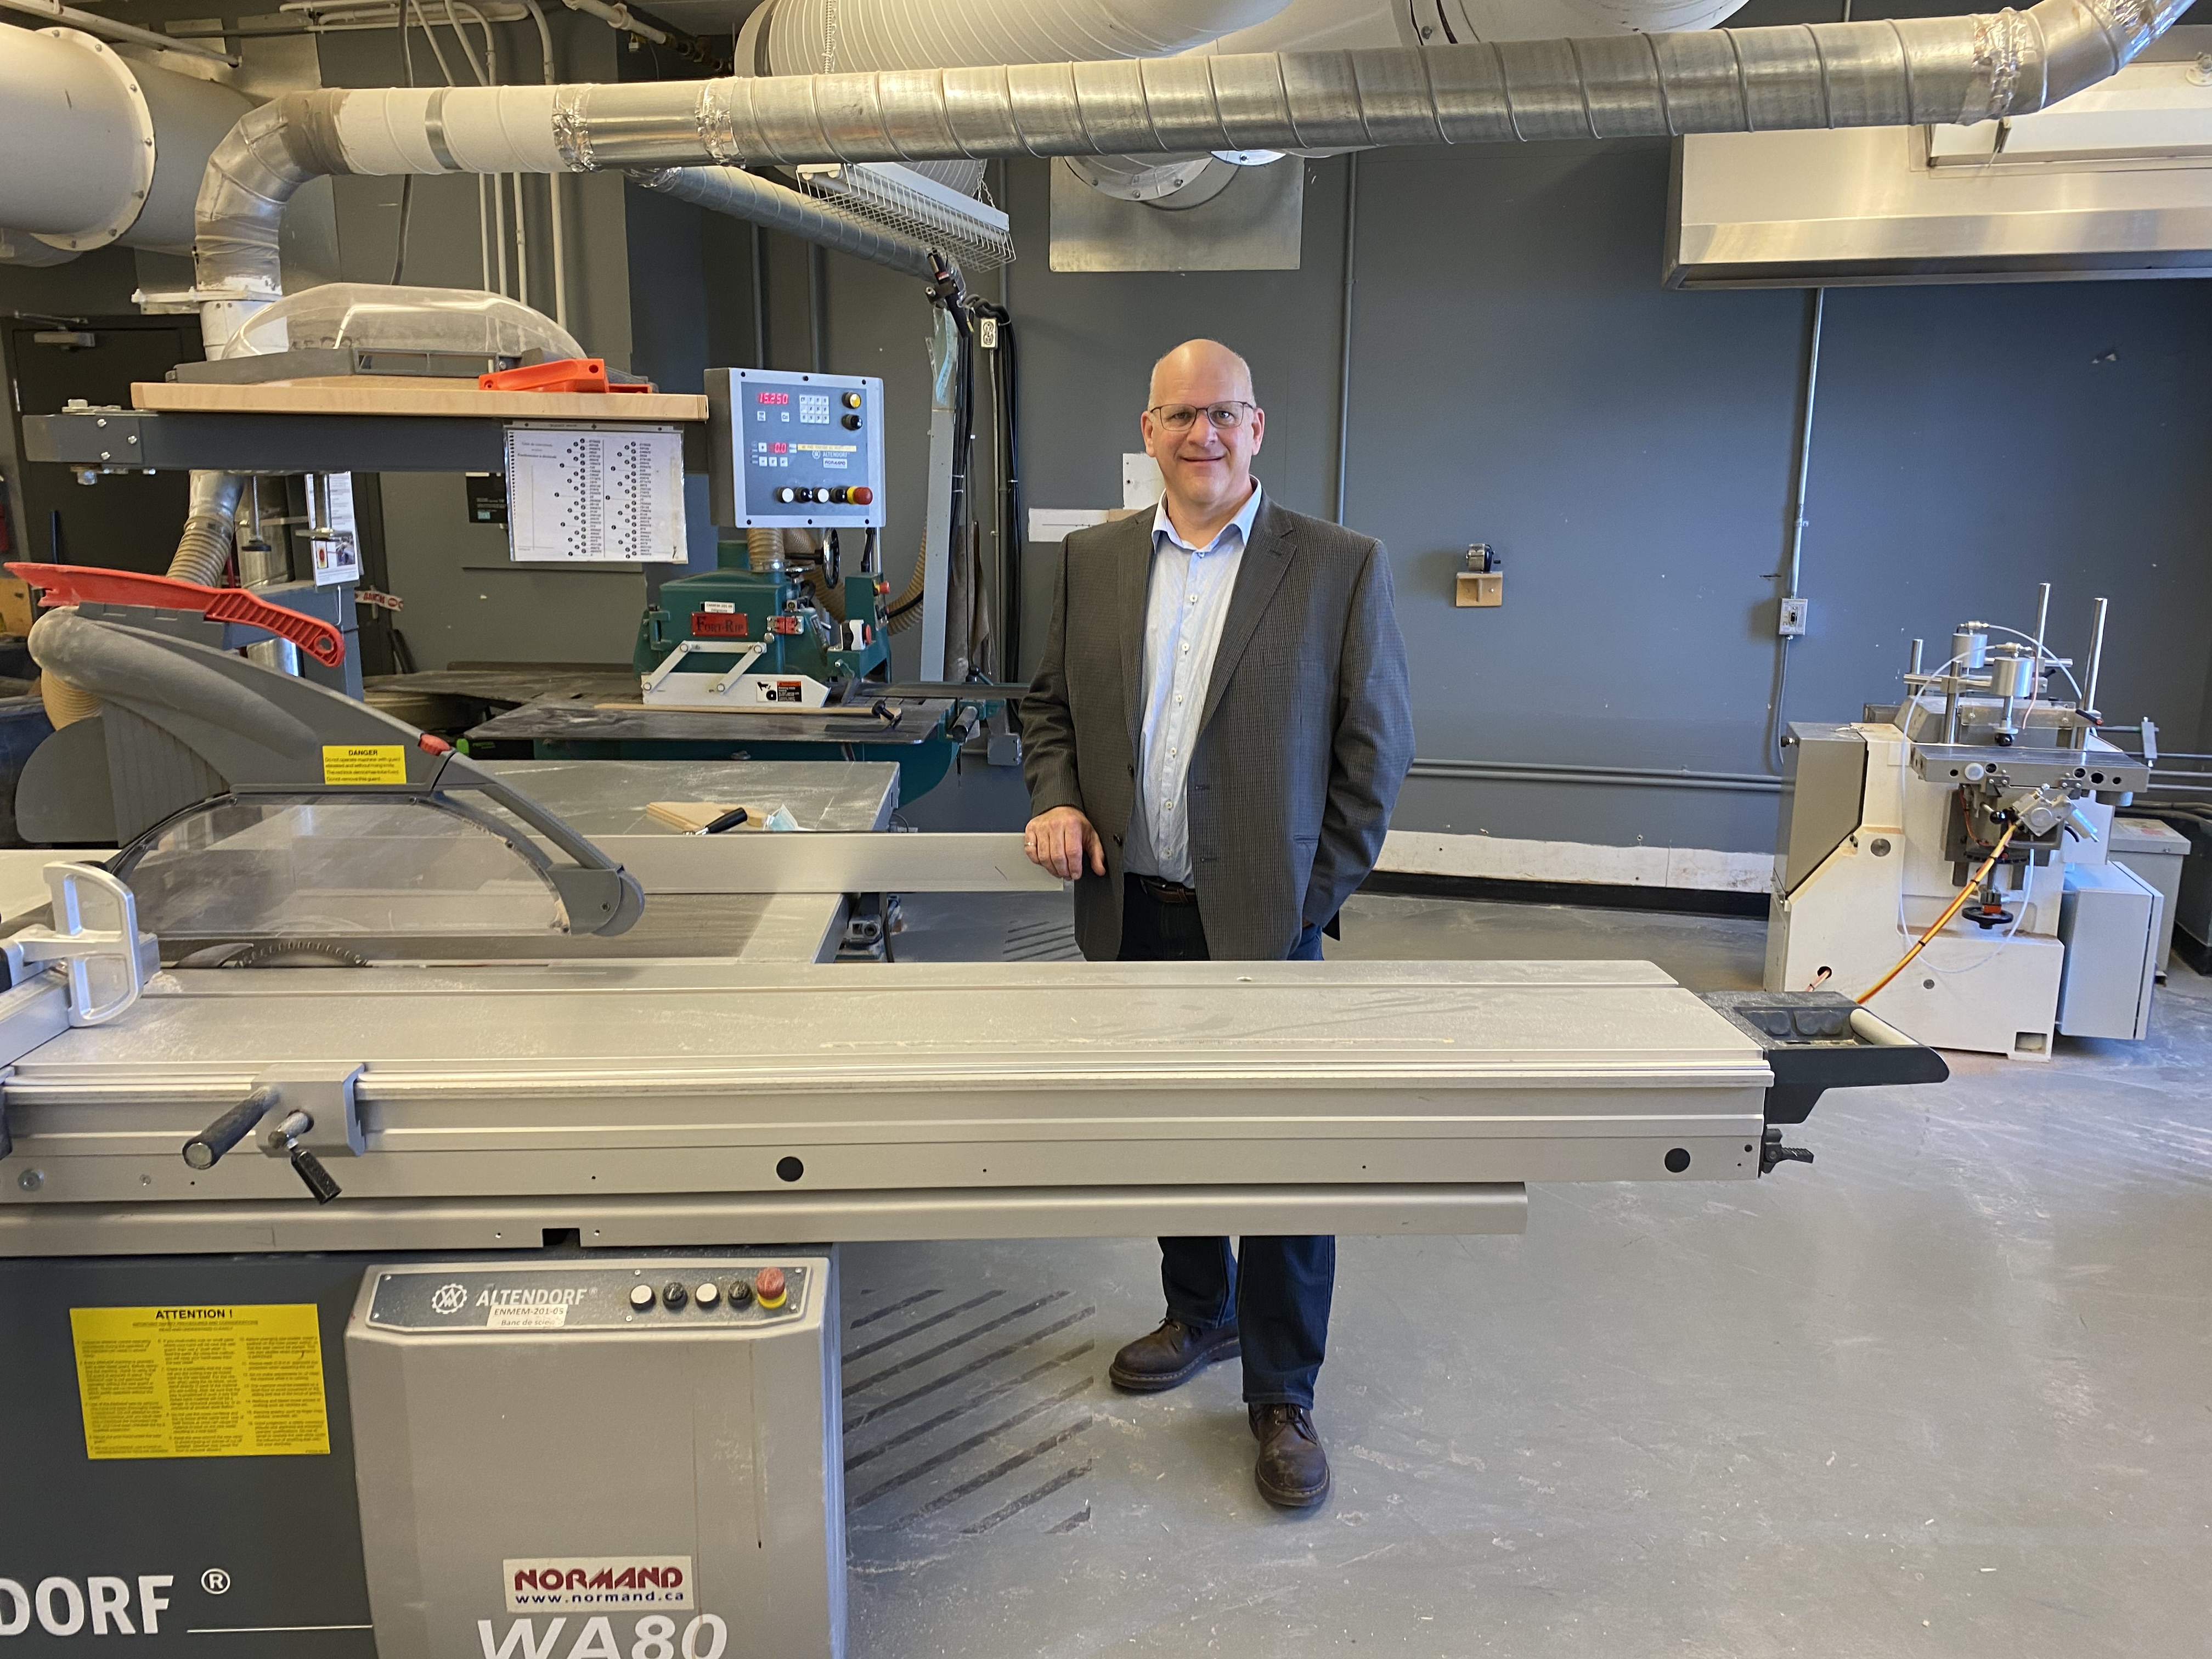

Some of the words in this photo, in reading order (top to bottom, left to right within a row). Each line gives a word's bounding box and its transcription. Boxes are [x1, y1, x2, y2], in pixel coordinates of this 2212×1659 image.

[156, 1309, 225, 1319] ATTENTION
[494, 1307, 564, 1316] ENMEM-201-05
[514, 1566, 683, 1590] NORMAND
[515, 1591, 684, 1604] www.normand.ca
[477, 1613, 727, 1659] WA80
